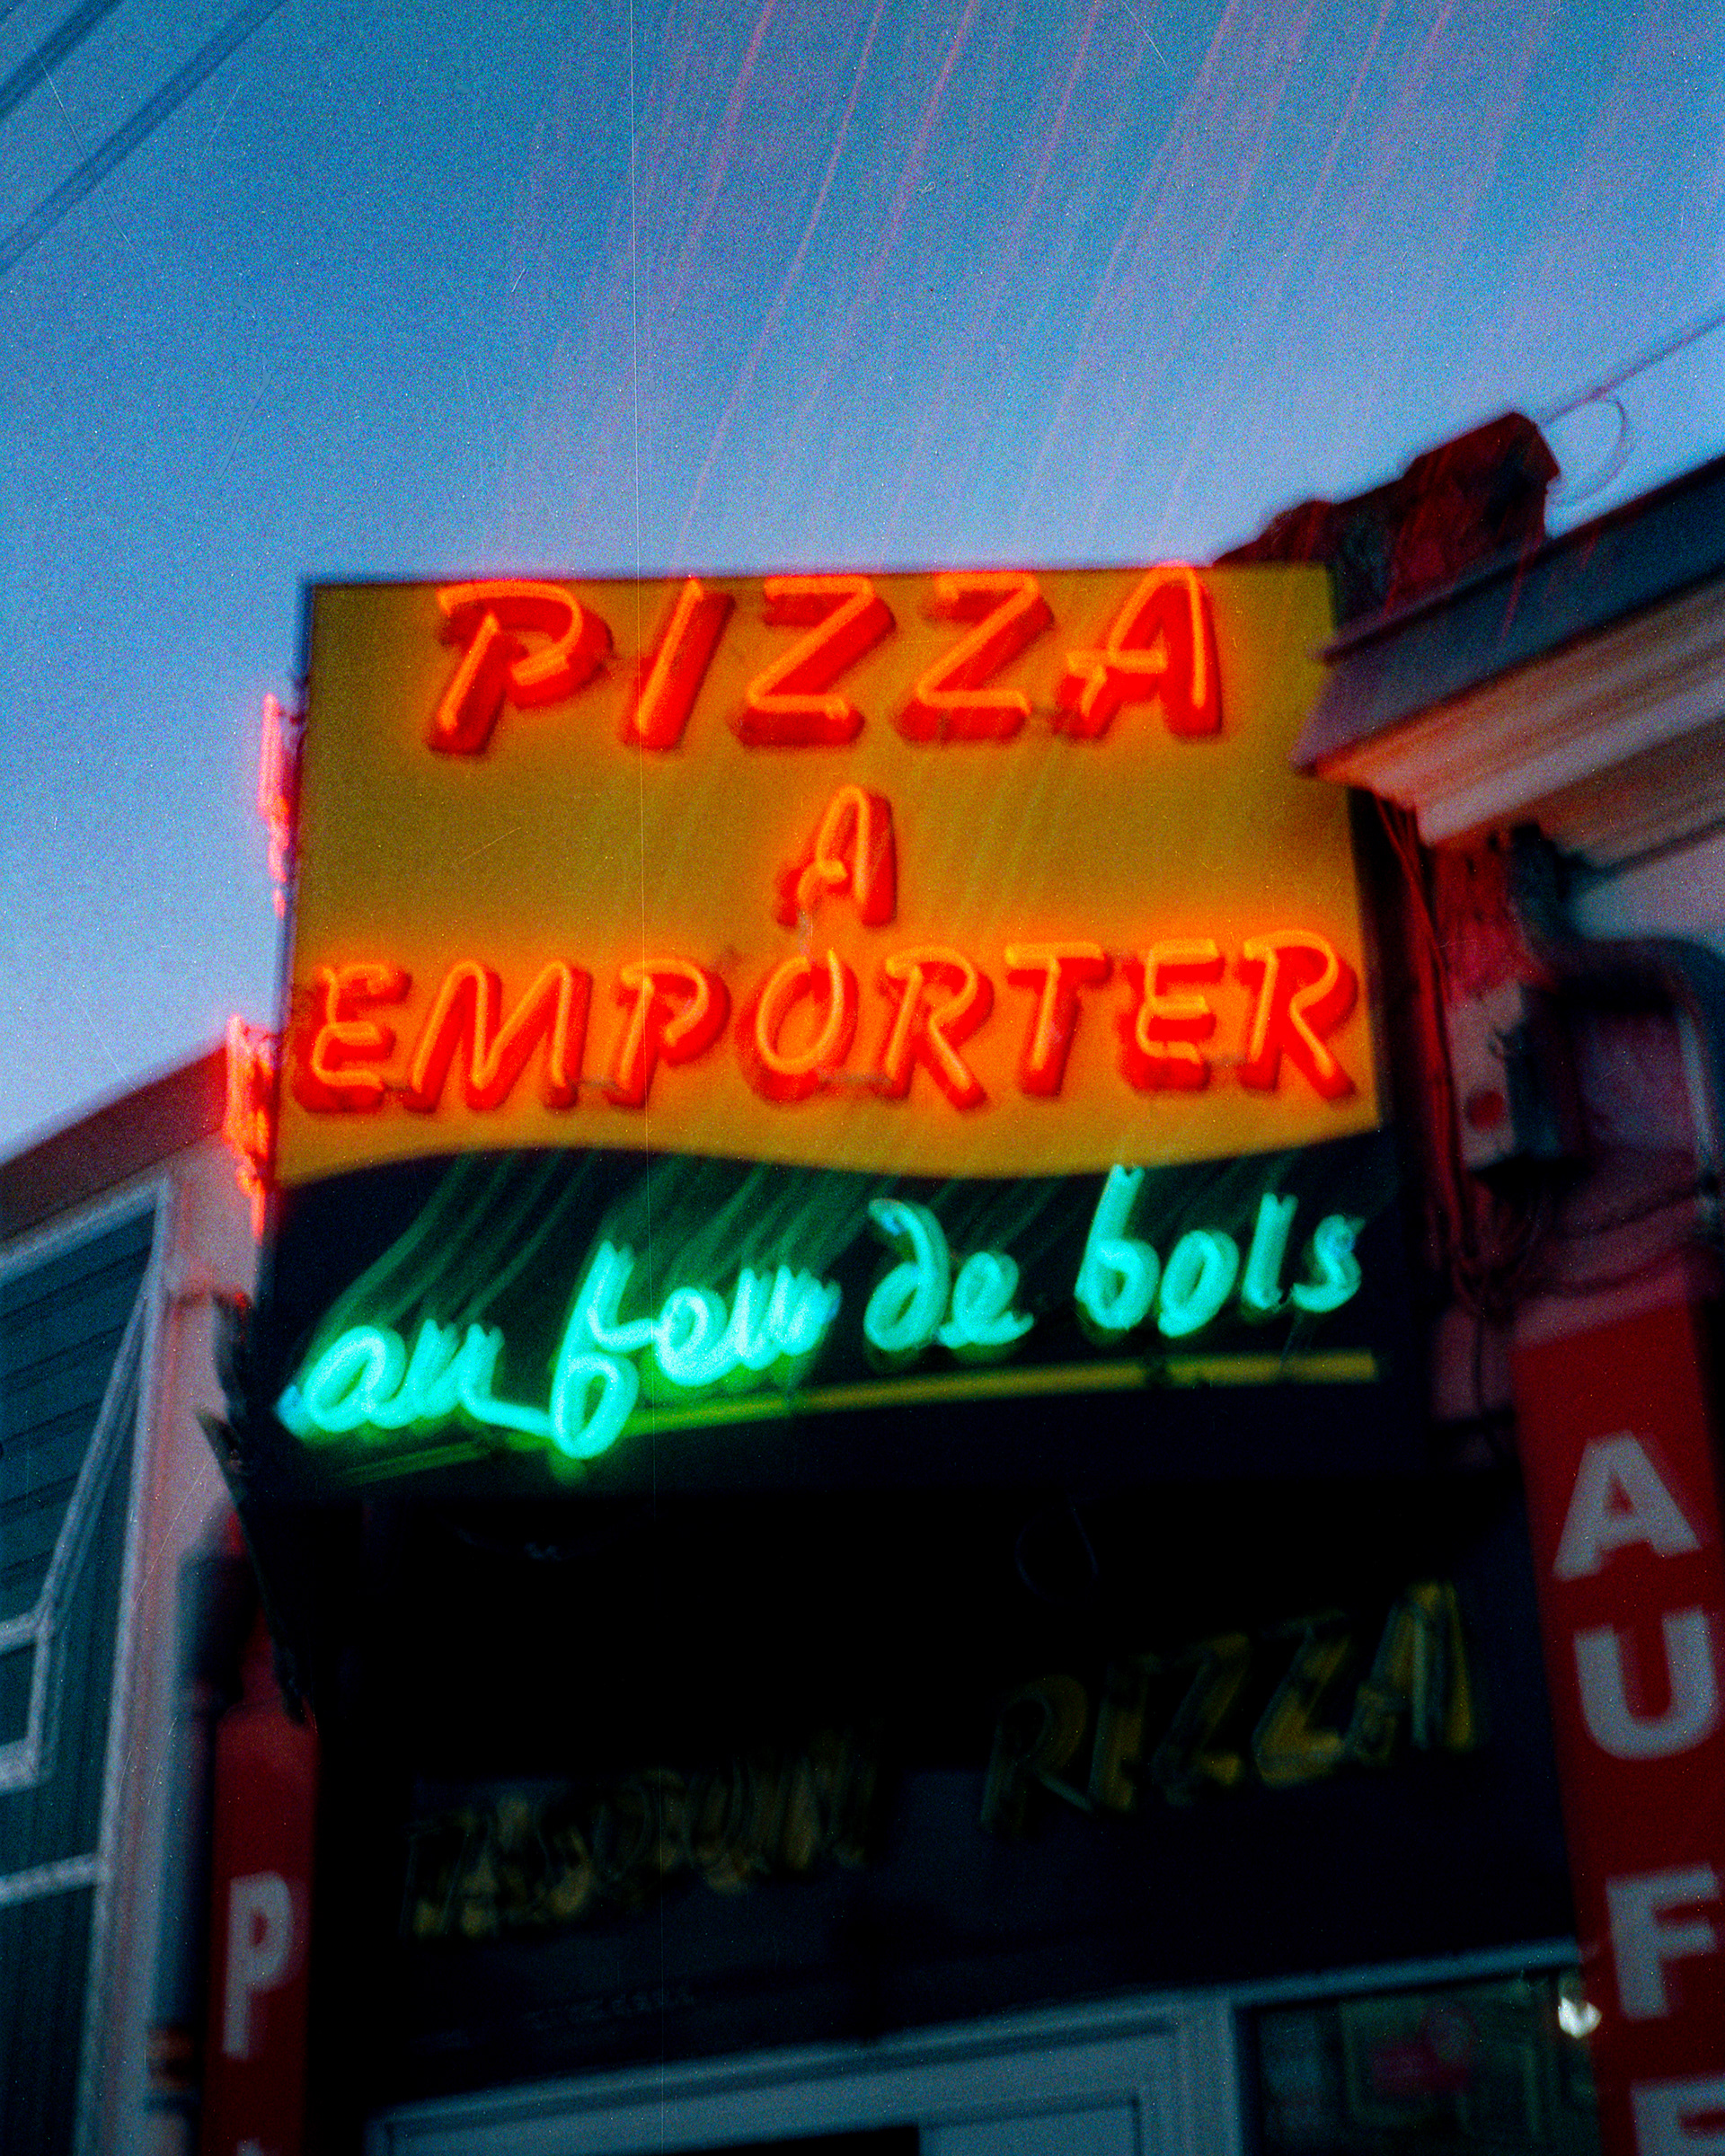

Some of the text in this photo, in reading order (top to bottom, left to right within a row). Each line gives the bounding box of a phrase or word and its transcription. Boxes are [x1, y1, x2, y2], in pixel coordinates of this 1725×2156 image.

[425, 561, 1224, 758] PIZZA
[776, 783, 898, 927] A
[292, 929, 1358, 1109] EMPORTER
[272, 1317, 539, 1439] au
[863, 1197, 1034, 1351] de
[1073, 1163, 1367, 1339] bois
